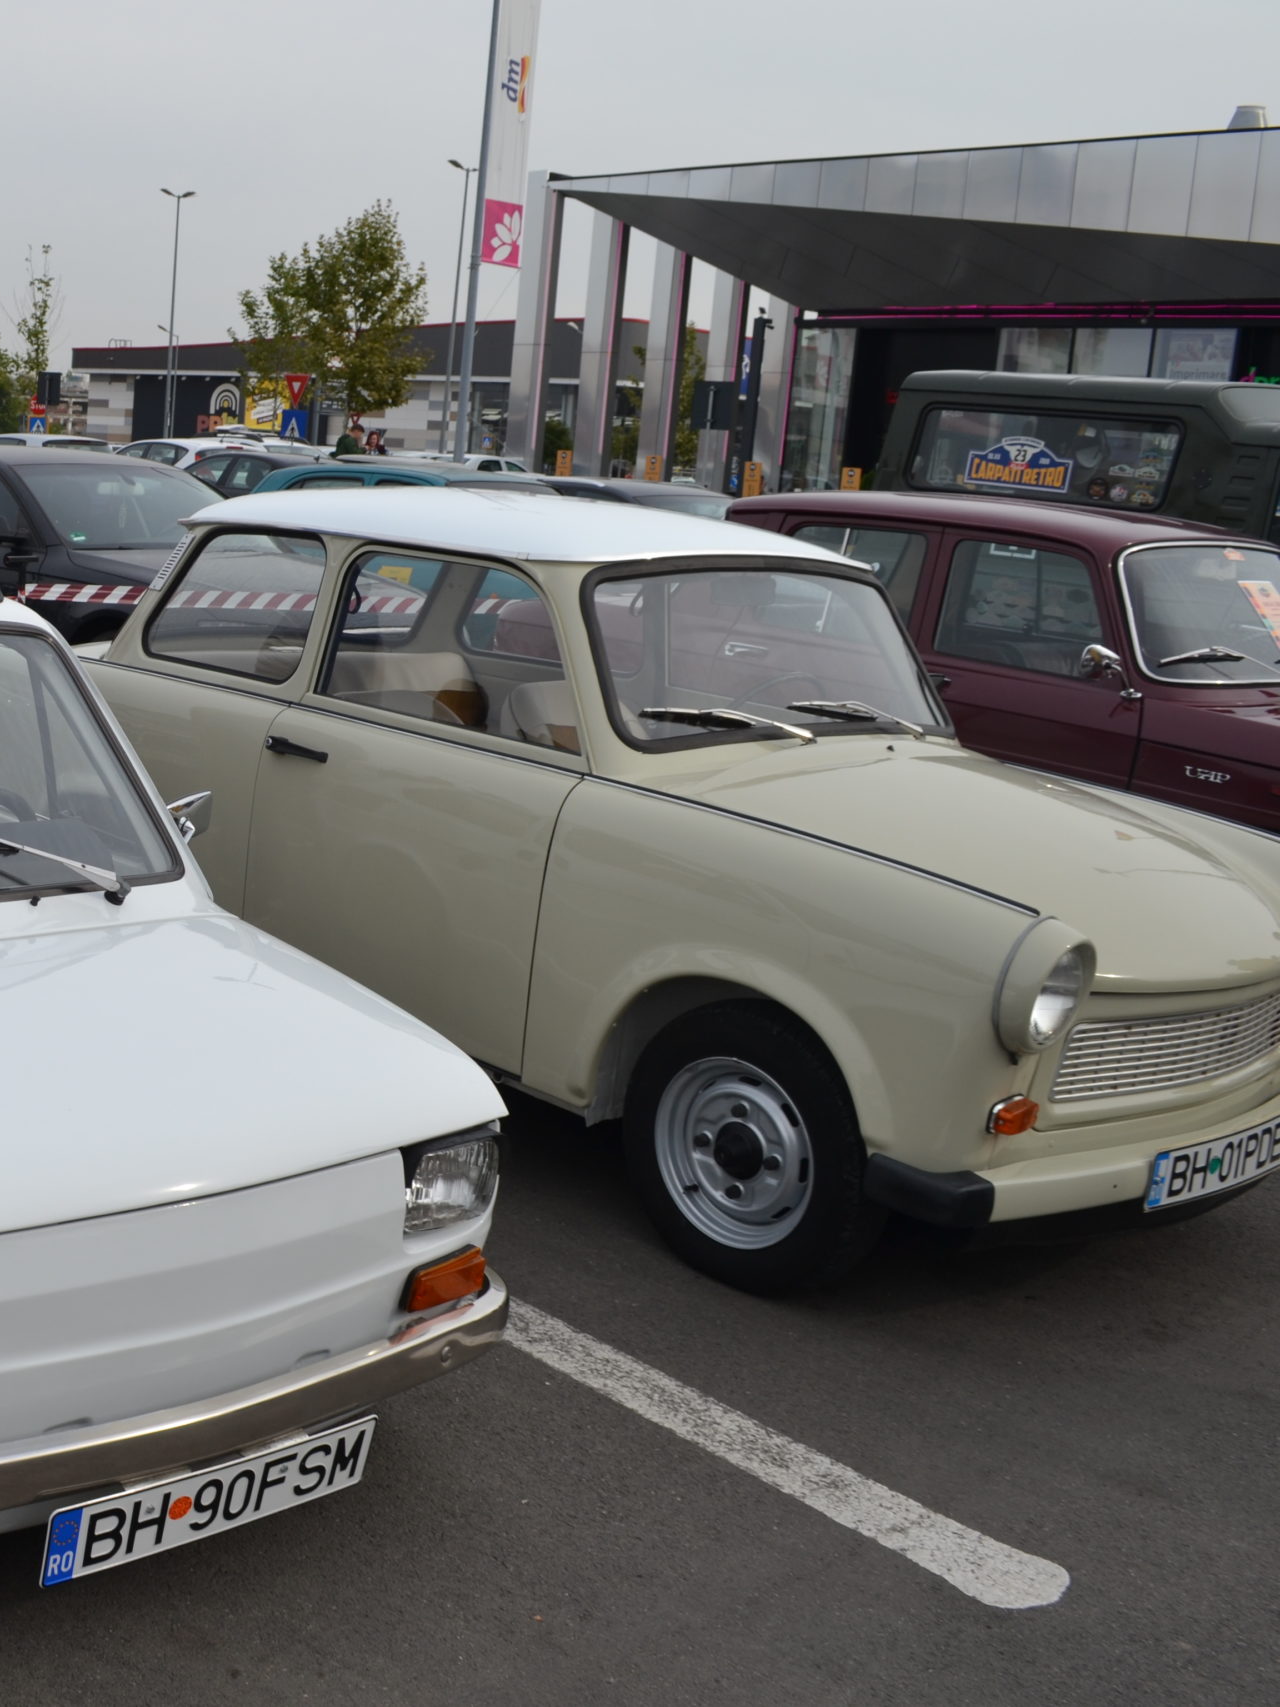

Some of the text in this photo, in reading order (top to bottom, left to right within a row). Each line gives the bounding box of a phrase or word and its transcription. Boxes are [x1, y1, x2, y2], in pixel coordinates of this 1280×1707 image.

[501, 59, 520, 103] dm
[970, 457, 1067, 488] CARPATI RETRO
[1014, 449, 1028, 462] 23
[1167, 1147, 1212, 1198] BH
[82, 1429, 366, 1568] BH 90FSM
[47, 1550, 74, 1577] RO
